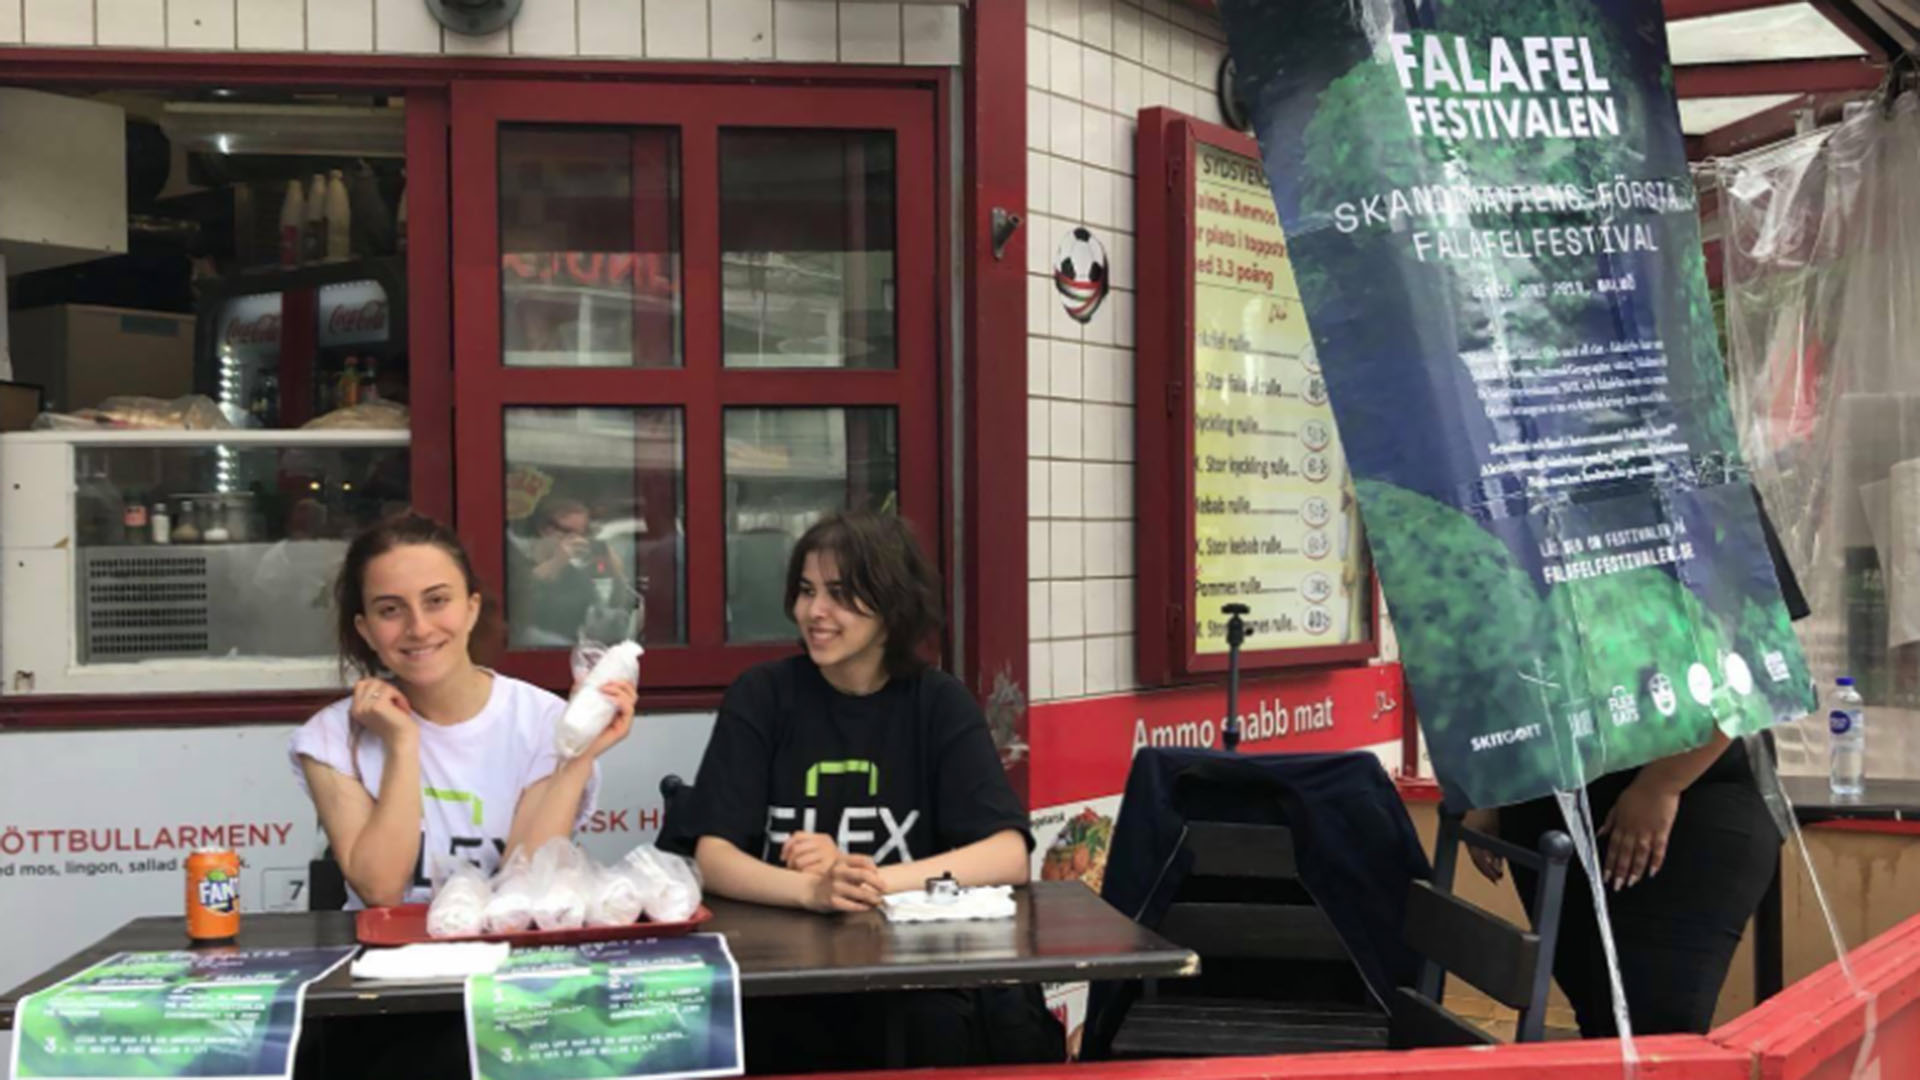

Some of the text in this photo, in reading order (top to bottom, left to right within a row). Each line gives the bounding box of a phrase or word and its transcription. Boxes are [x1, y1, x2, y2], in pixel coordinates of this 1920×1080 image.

[1388, 32, 1610, 92] FALAFEL
[1405, 96, 1620, 140] FESTIVALEN
[1598, 174, 1677, 213] FÖRSTA
[1413, 222, 1659, 262] FALAFELFESTIVAL
[1215, 257, 1234, 278] 3.3
[1236, 262, 1274, 290] poäng
[1206, 456, 1227, 474] Stor
[1206, 536, 1229, 557] Stor
[1133, 718, 1215, 750] Ammo
[1293, 696, 1335, 733] mat
[580, 808, 630, 834] SK
[0, 822, 294, 855] ÖTTBULLARMENY
[0, 863, 15, 877] ed
[19, 863, 61, 879] mos,
[65, 858, 124, 877] lingon,
[128, 857, 177, 872] sallad
